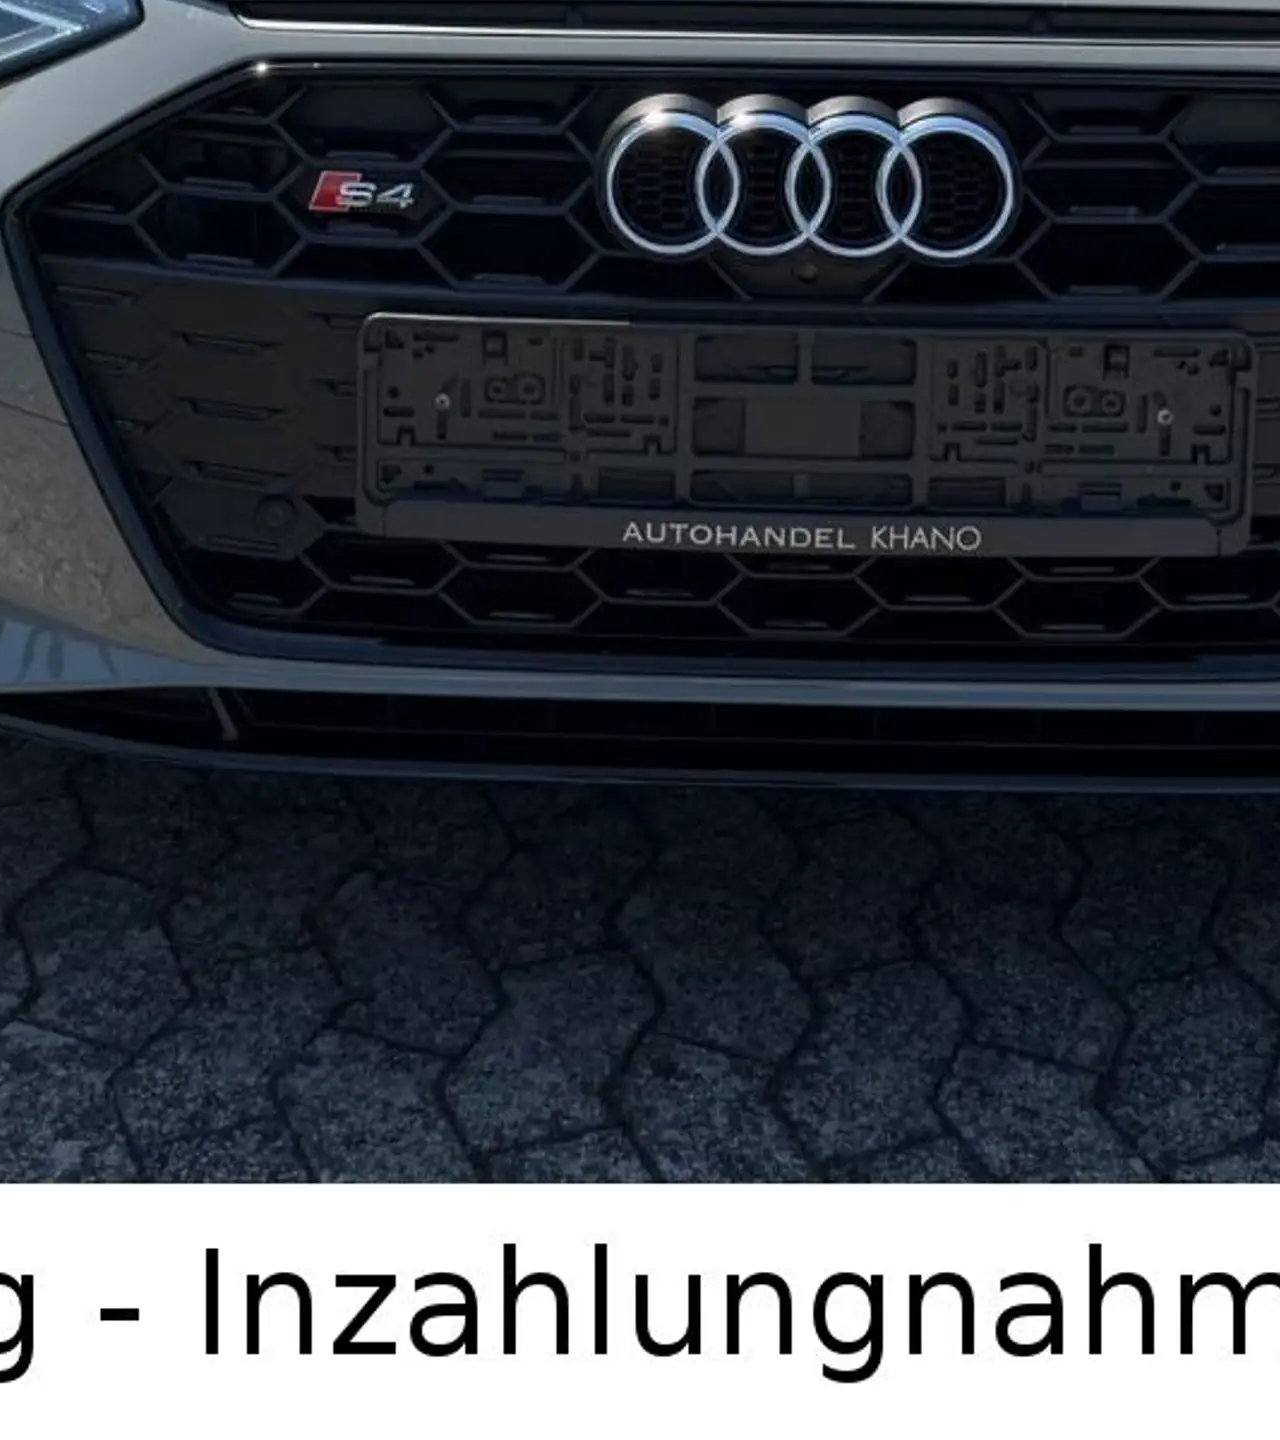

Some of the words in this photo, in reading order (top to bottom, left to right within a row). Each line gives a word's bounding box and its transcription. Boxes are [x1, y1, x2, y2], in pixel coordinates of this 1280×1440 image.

[335, 181, 415, 209] S4
[621, 520, 856, 550] AUTOHANDEL
[869, 525, 982, 552] KHANO
